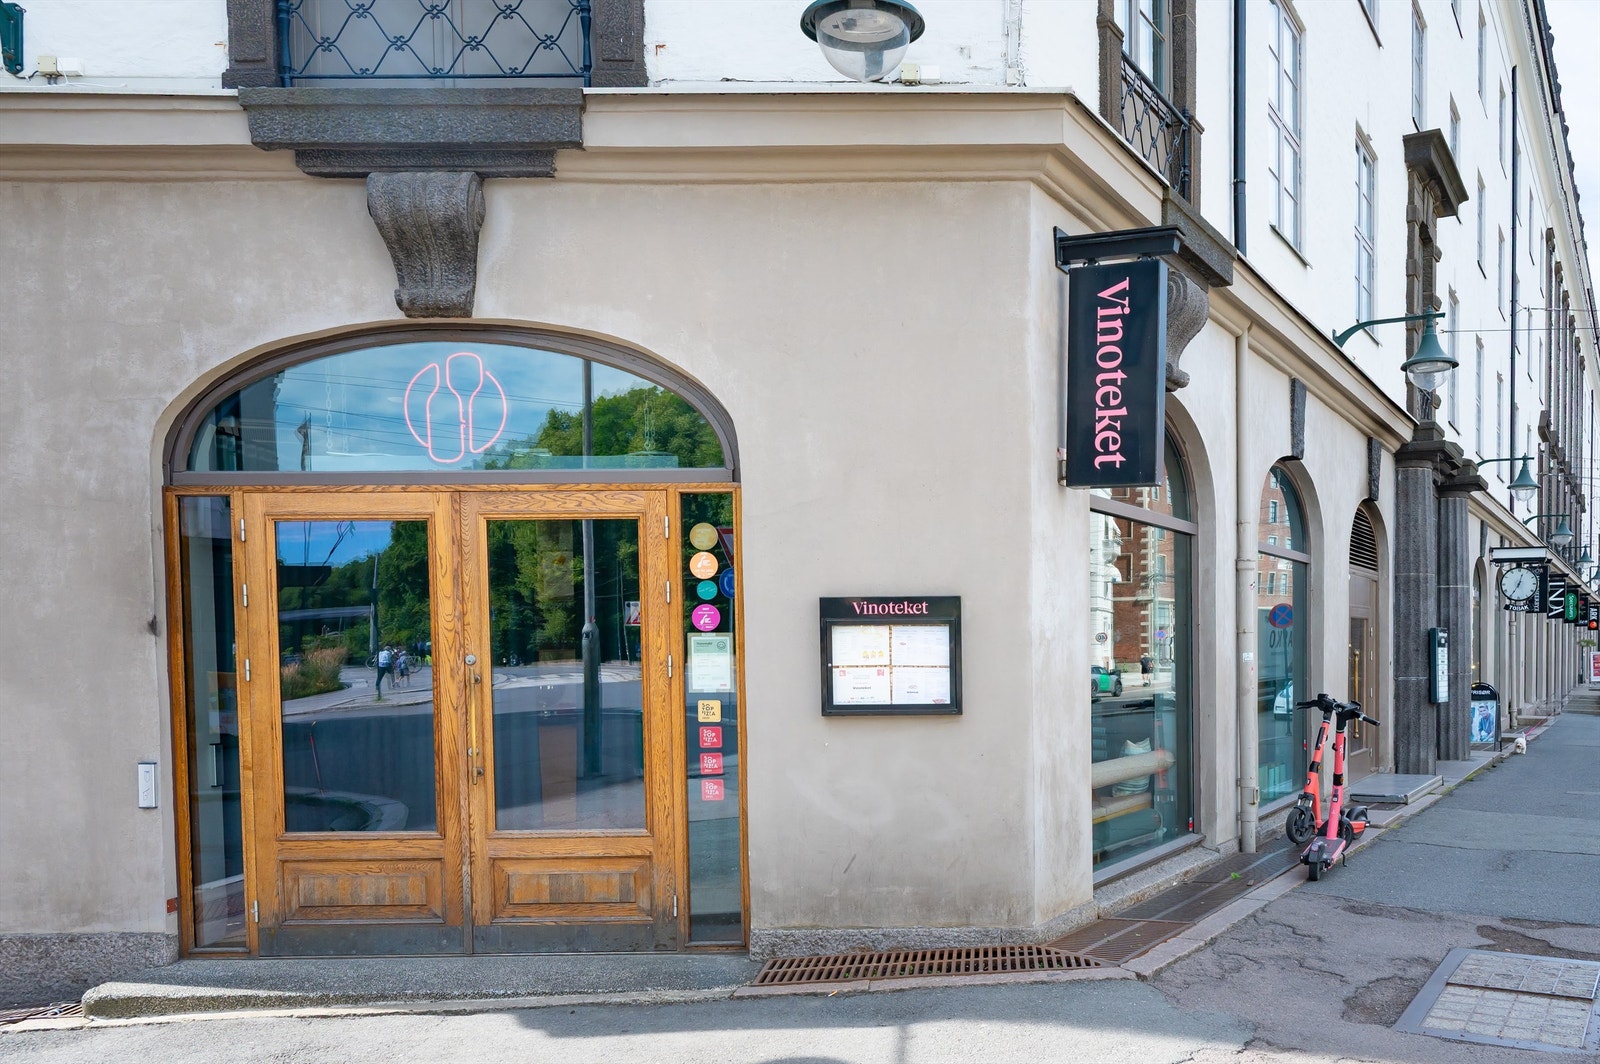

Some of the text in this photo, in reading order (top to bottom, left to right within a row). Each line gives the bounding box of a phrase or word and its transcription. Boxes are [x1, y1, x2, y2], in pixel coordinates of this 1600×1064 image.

[1094, 276, 1131, 470] Vinoteket
[852, 600, 929, 615] Vinoteket
[1589, 608, 1597, 620] ARK
